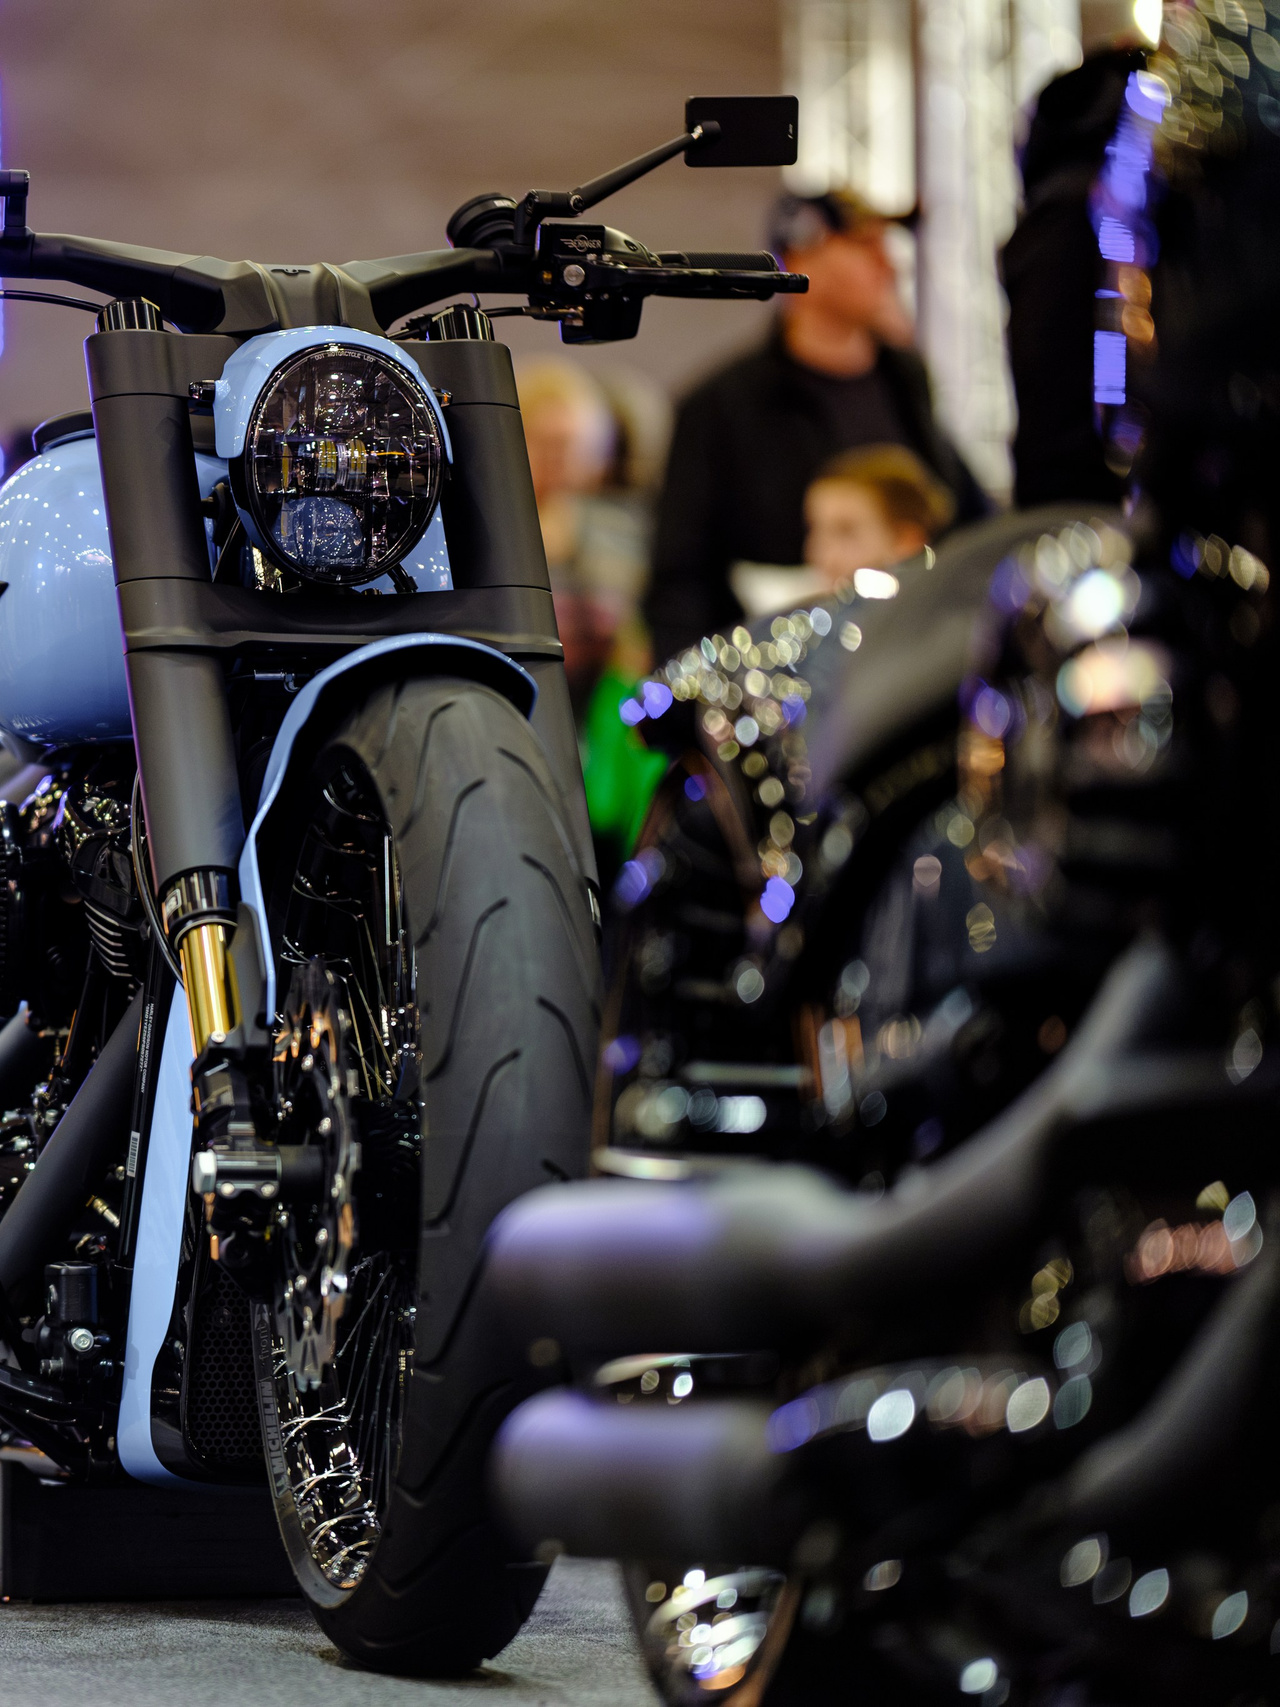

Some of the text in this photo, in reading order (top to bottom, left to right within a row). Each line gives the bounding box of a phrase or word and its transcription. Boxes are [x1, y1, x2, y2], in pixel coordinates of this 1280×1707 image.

[560, 238, 602, 249] BERINGER
[327, 351, 361, 359] MOTORCYCLE
[258, 1322, 270, 1361] front
[261, 1381, 285, 1475] MICHELIN
